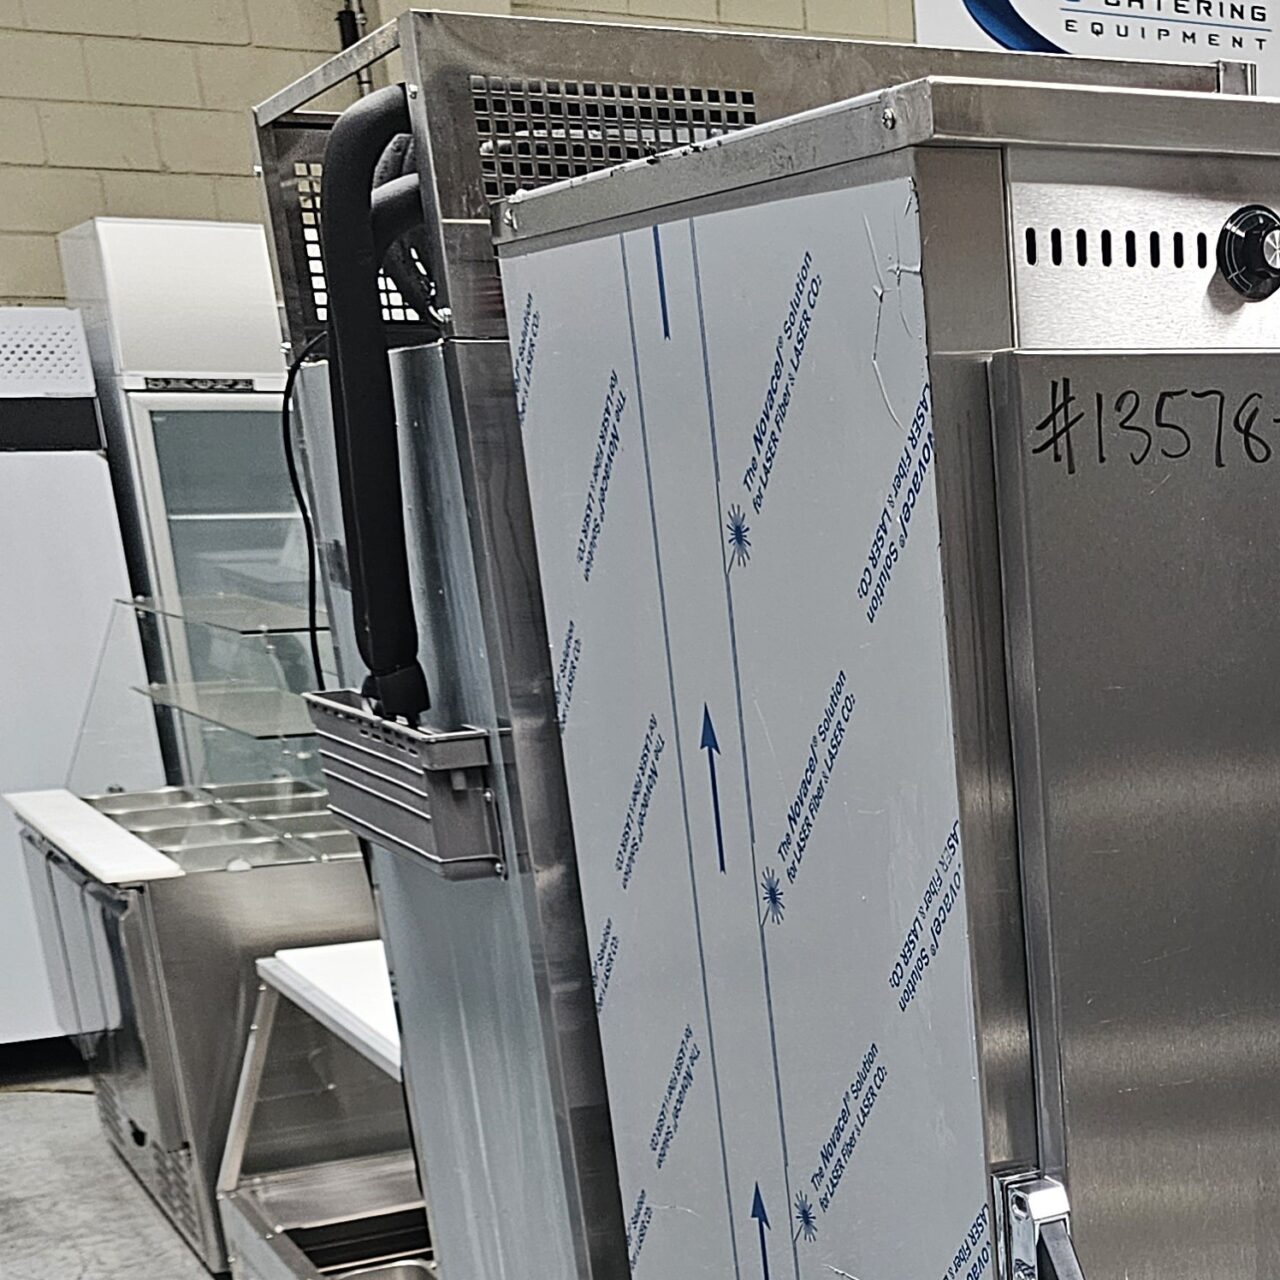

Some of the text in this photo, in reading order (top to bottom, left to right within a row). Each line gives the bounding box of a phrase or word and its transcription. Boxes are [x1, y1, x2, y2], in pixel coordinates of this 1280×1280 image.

[1065, 19, 1267, 51] EQUIPMENT
[742, 456, 757, 492] The
[783, 251, 811, 340] Solution
[752, 485, 763, 514] for
[758, 430, 778, 489] LASER
[774, 382, 790, 432] Fiber
[789, 308, 811, 372] LASER
[892, 445, 911, 498] Fiber
[866, 541, 898, 623] Solution
[868, 507, 892, 569] LASER
[777, 832, 791, 862] The
[817, 670, 846, 742] Solution
[786, 859, 797, 884] for
[792, 815, 812, 864] LASER
[808, 778, 824, 820] Fiber
[823, 719, 845, 773] LASER
[898, 864, 961, 1012] ovacel® Solution
[923, 868, 942, 911] Fiber
[899, 915, 923, 966] LASER
[810, 1166, 824, 1191] The
[850, 1042, 878, 1100] Solution
[825, 1157, 845, 1198] LASER
[840, 1130, 856, 1164] Fiber
[855, 1084, 877, 1127] LASER
[952, 1238, 971, 1273] Fiber
